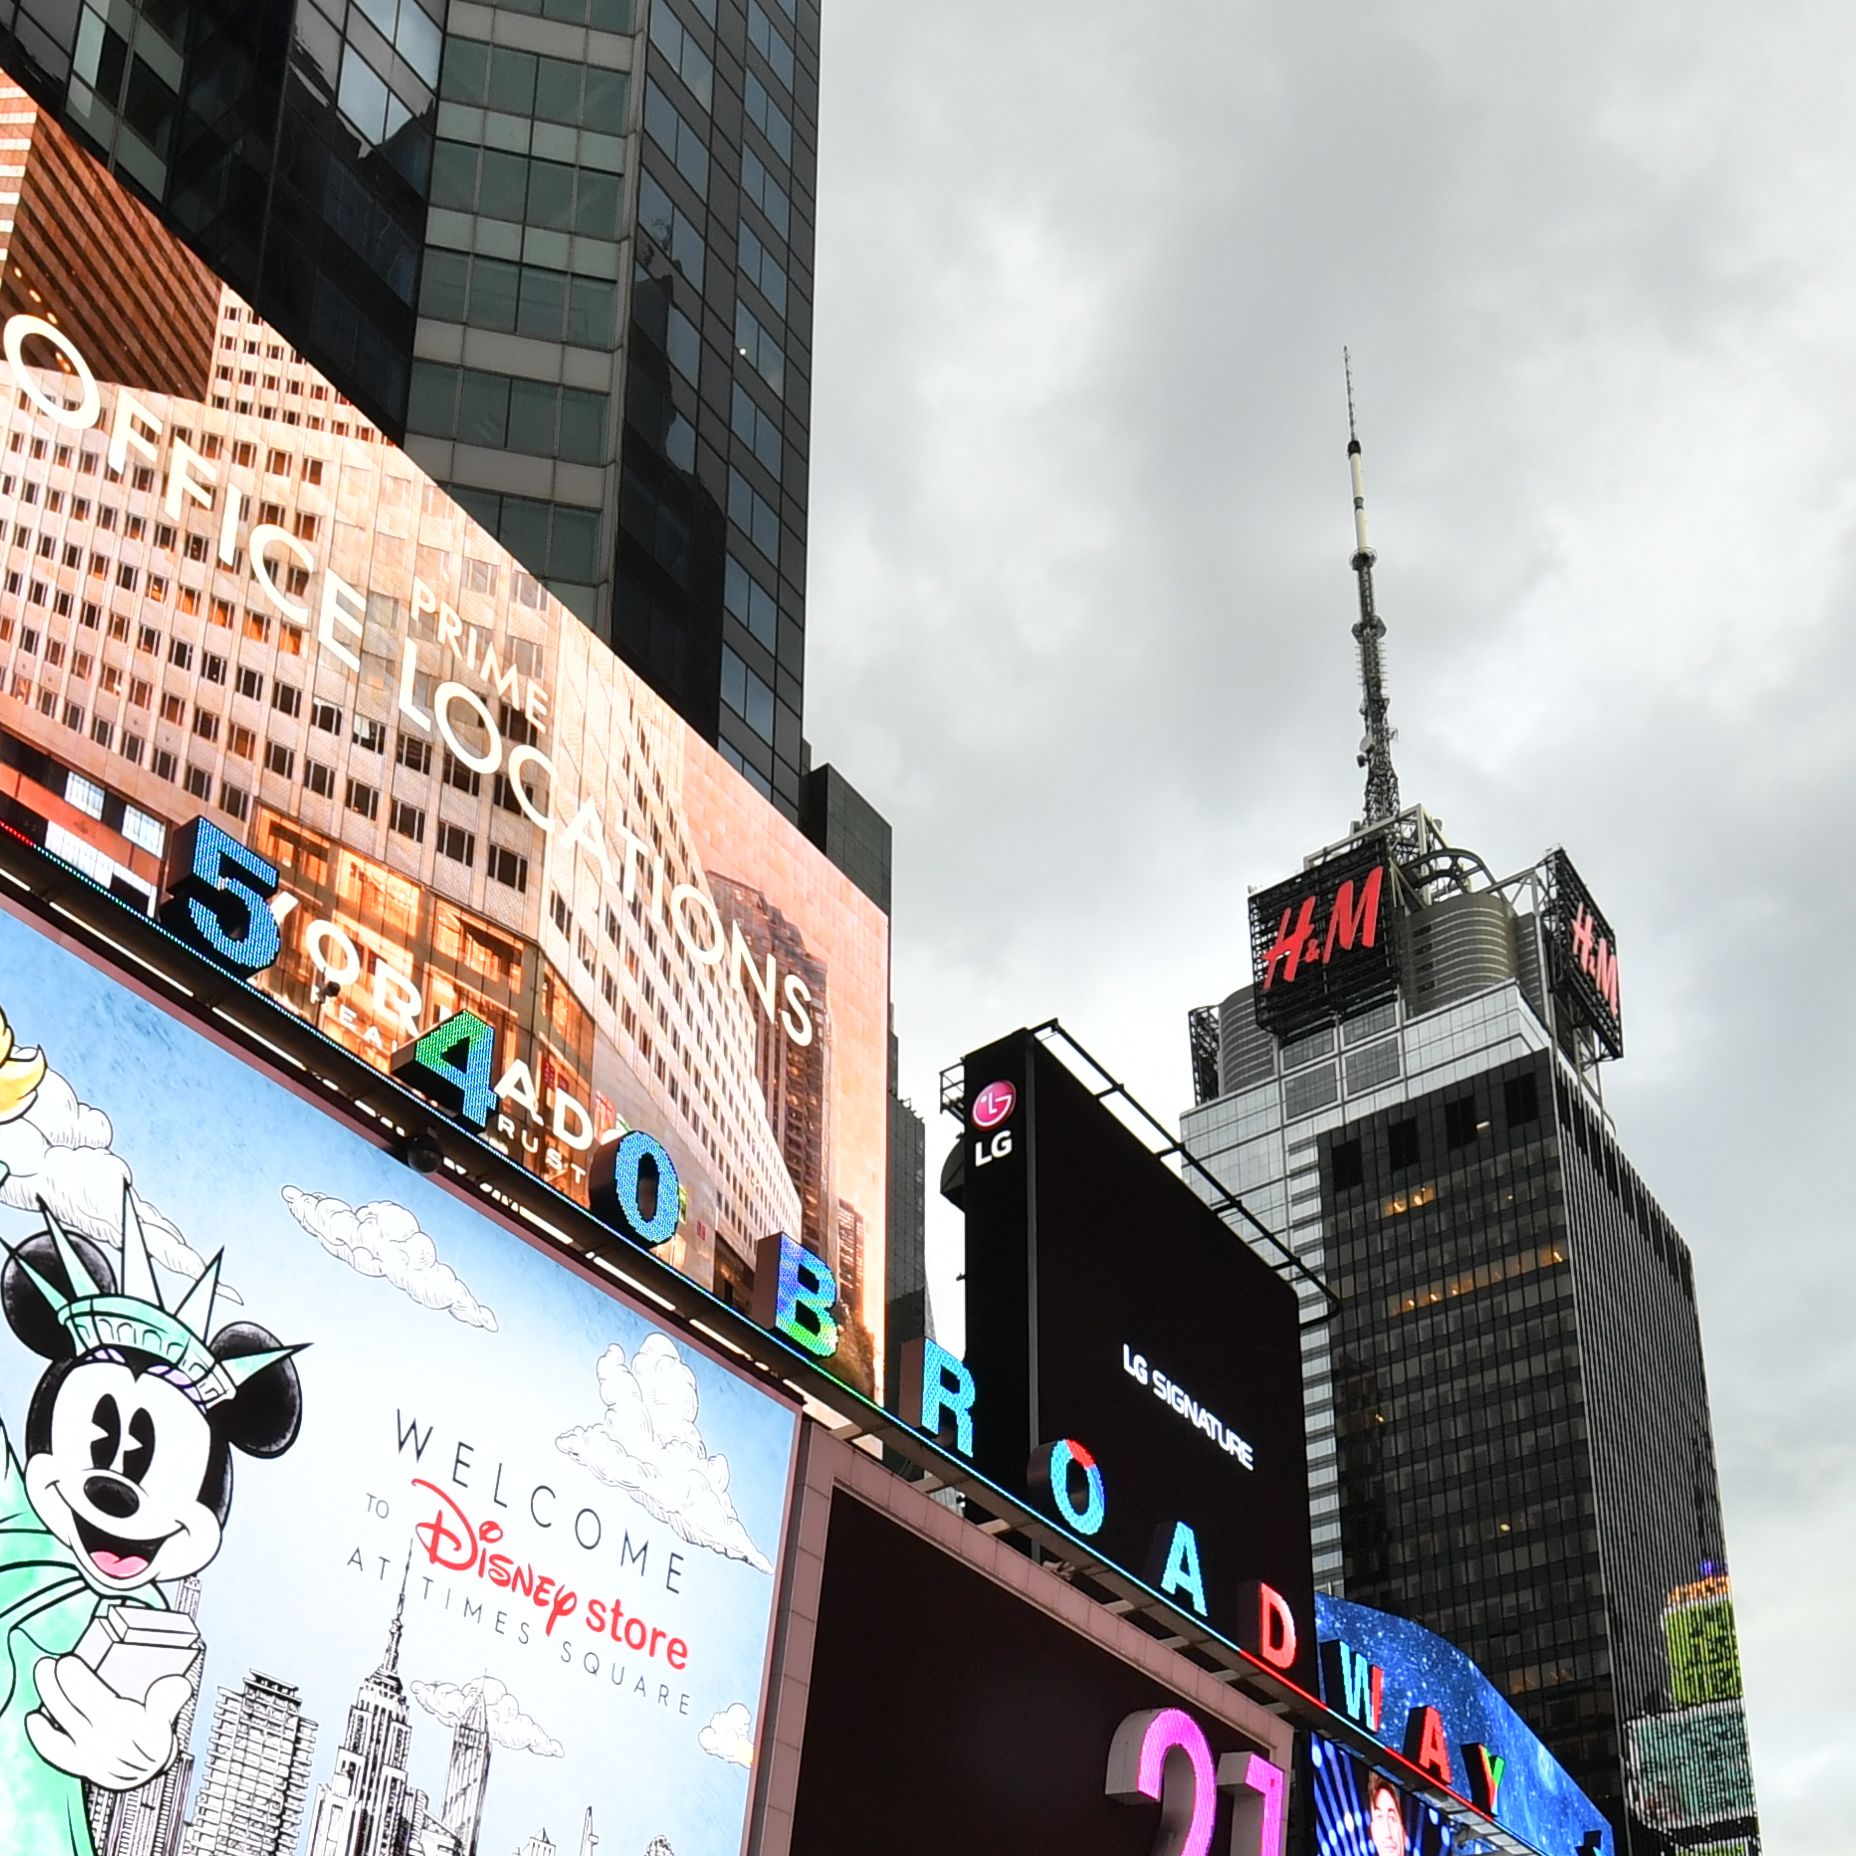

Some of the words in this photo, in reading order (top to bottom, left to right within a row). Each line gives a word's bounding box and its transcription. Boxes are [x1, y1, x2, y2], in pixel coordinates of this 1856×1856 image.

[3, 314, 364, 675] OFFICE
[398, 638, 814, 1047] LOCATIONS
[411, 579, 549, 734] PRIME
[1261, 864, 1385, 990] H&M
[1571, 902, 1619, 1021] H&M
[974, 1129, 1014, 1168] LG
[1121, 1343, 1149, 1388] LG
[1151, 1368, 1254, 1471] SIGNATURE
[364, 1492, 390, 1520] TO
[411, 1478, 578, 1638] Disney
[585, 1598, 689, 1671] store
[395, 1408, 685, 1595] WELCOME
[758, 1231, 1506, 1818] BROADWAY
[347, 1546, 392, 1582] AT
[421, 1576, 531, 1646] TIMES
[560, 1640, 692, 1717] SQUARE
